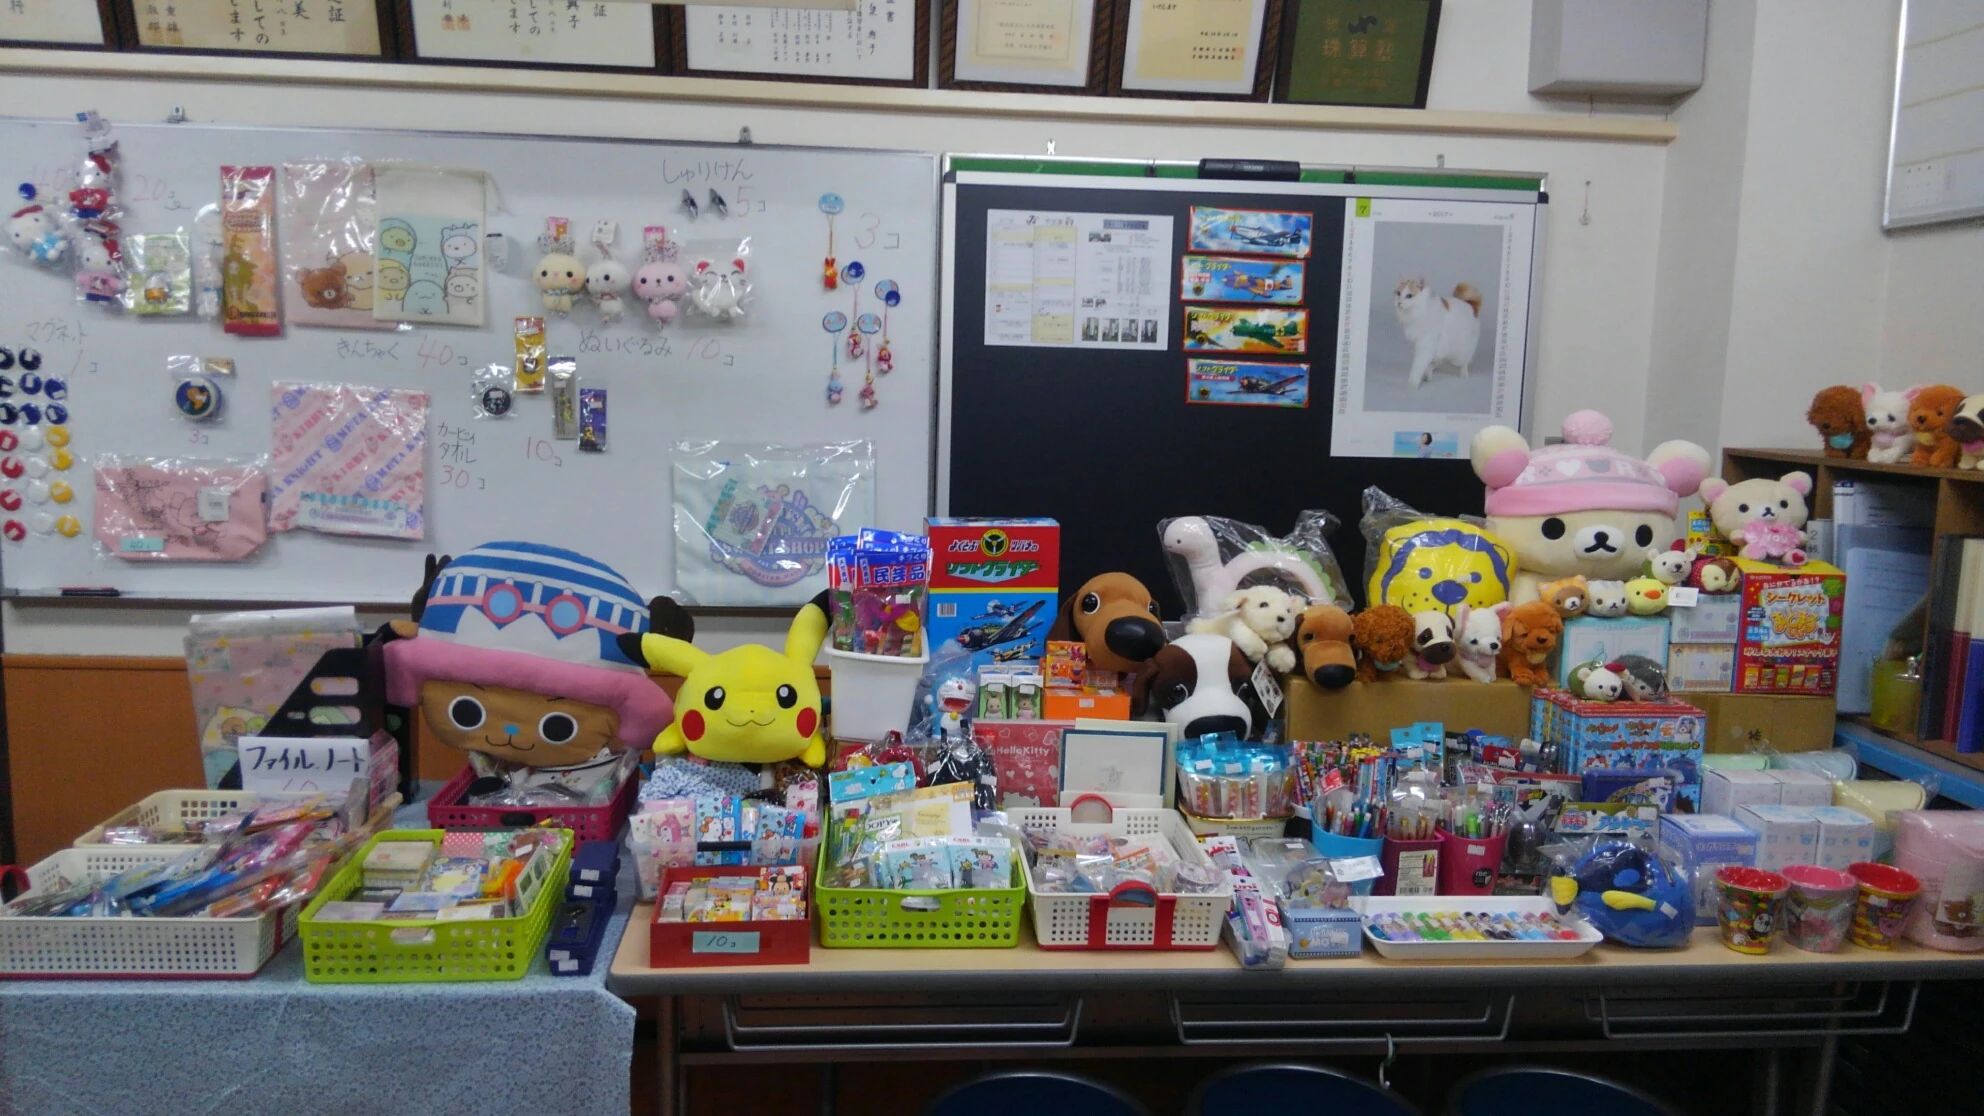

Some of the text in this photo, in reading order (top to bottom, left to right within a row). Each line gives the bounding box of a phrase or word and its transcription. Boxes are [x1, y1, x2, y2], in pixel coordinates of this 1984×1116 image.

[661, 157, 754, 184] しゅりけん
[578, 328, 674, 356] ぬいぐるみ
[874, 564, 926, 584] 民芸品
